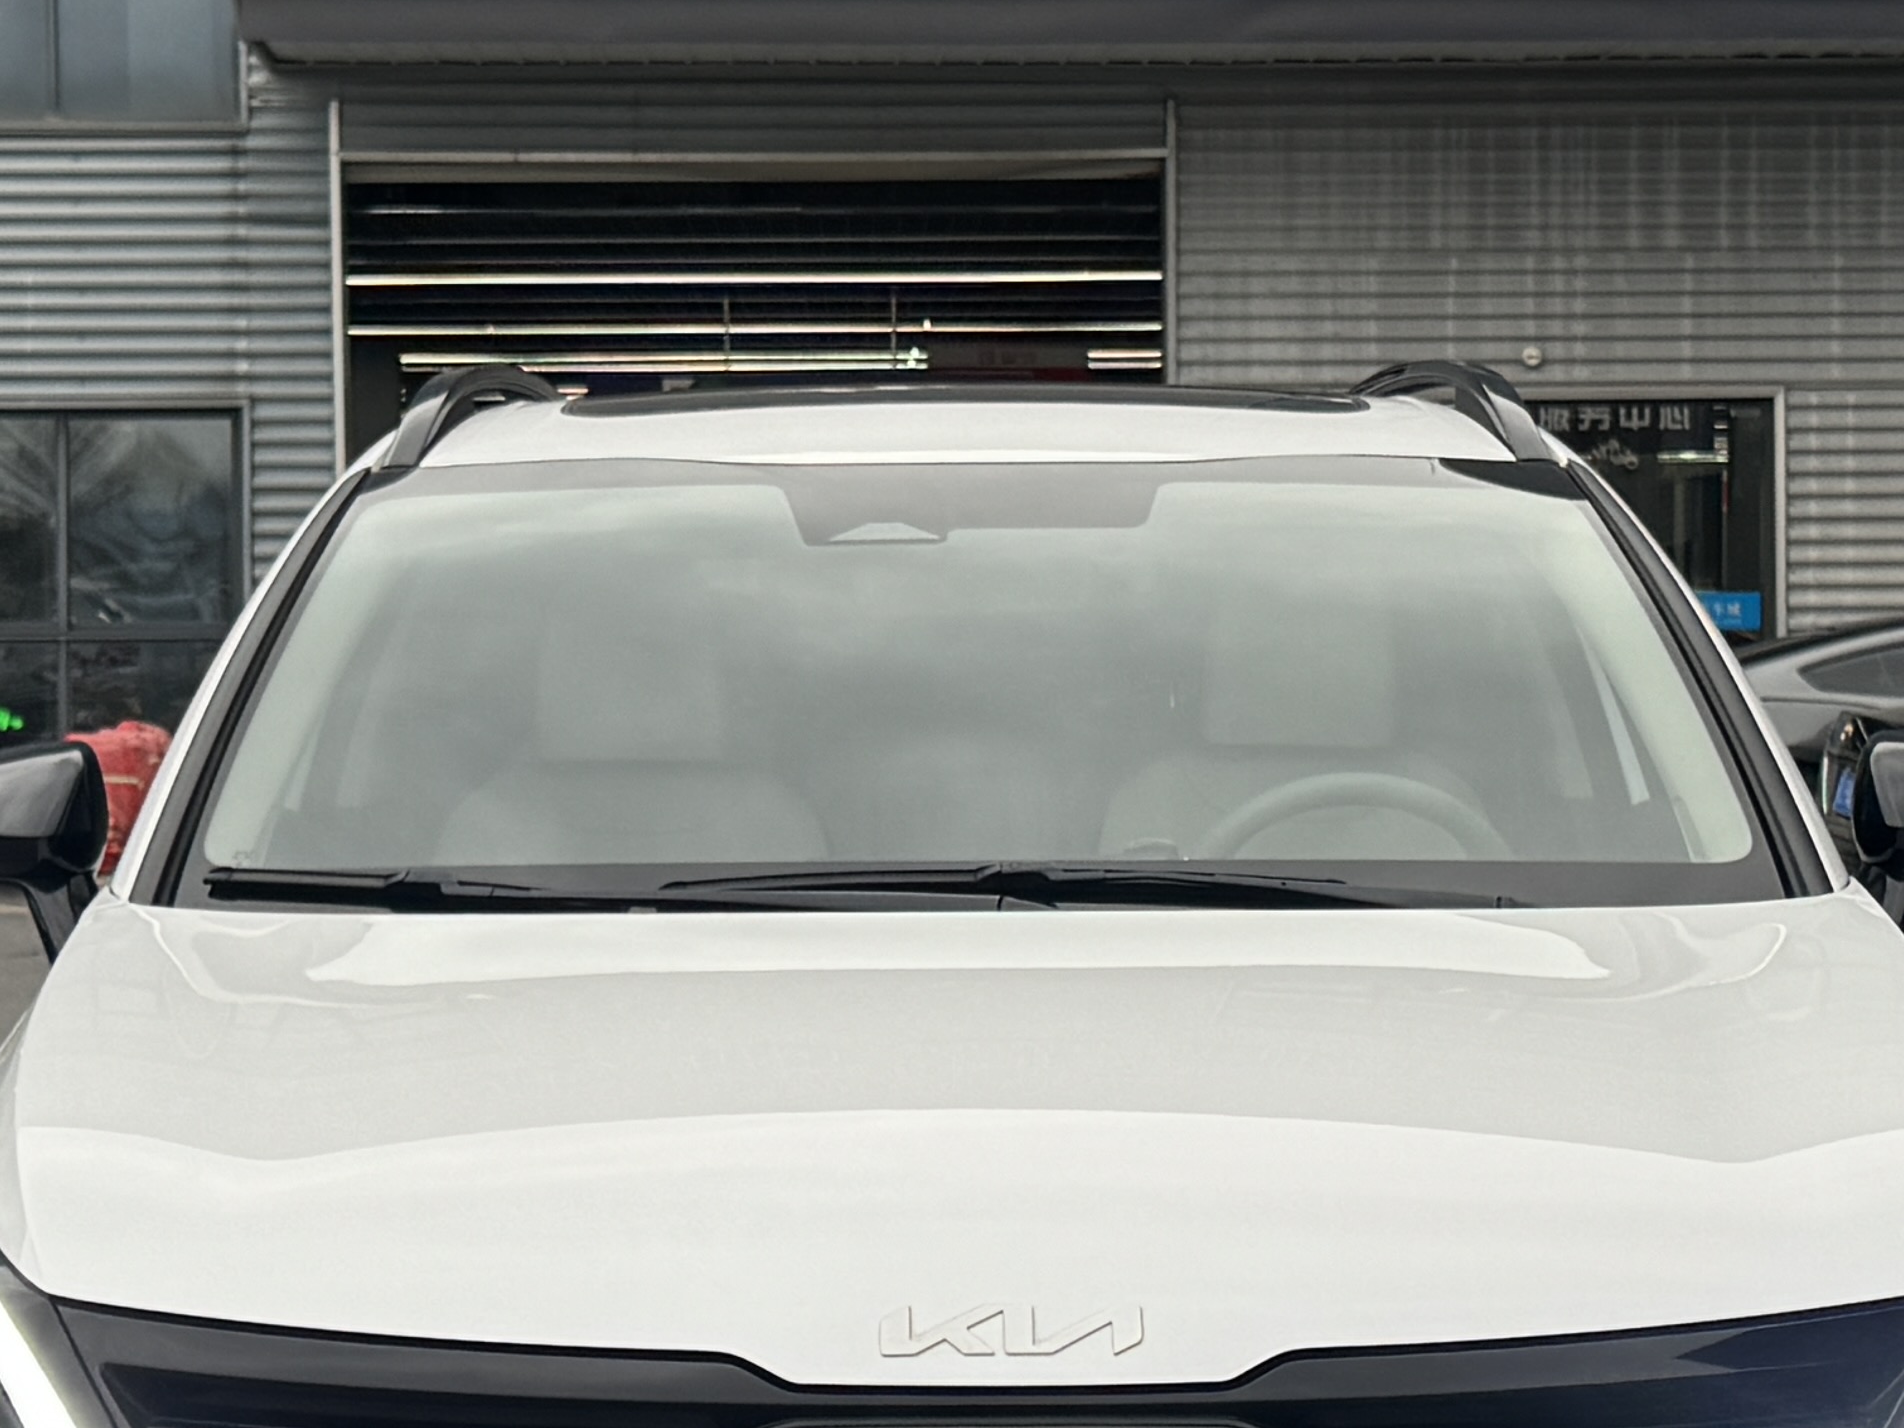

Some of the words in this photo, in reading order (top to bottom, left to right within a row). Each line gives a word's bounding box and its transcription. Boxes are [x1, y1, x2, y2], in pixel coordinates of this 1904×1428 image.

[1539, 406, 1691, 432] 服务中心
[879, 1304, 1144, 1357] KIA
